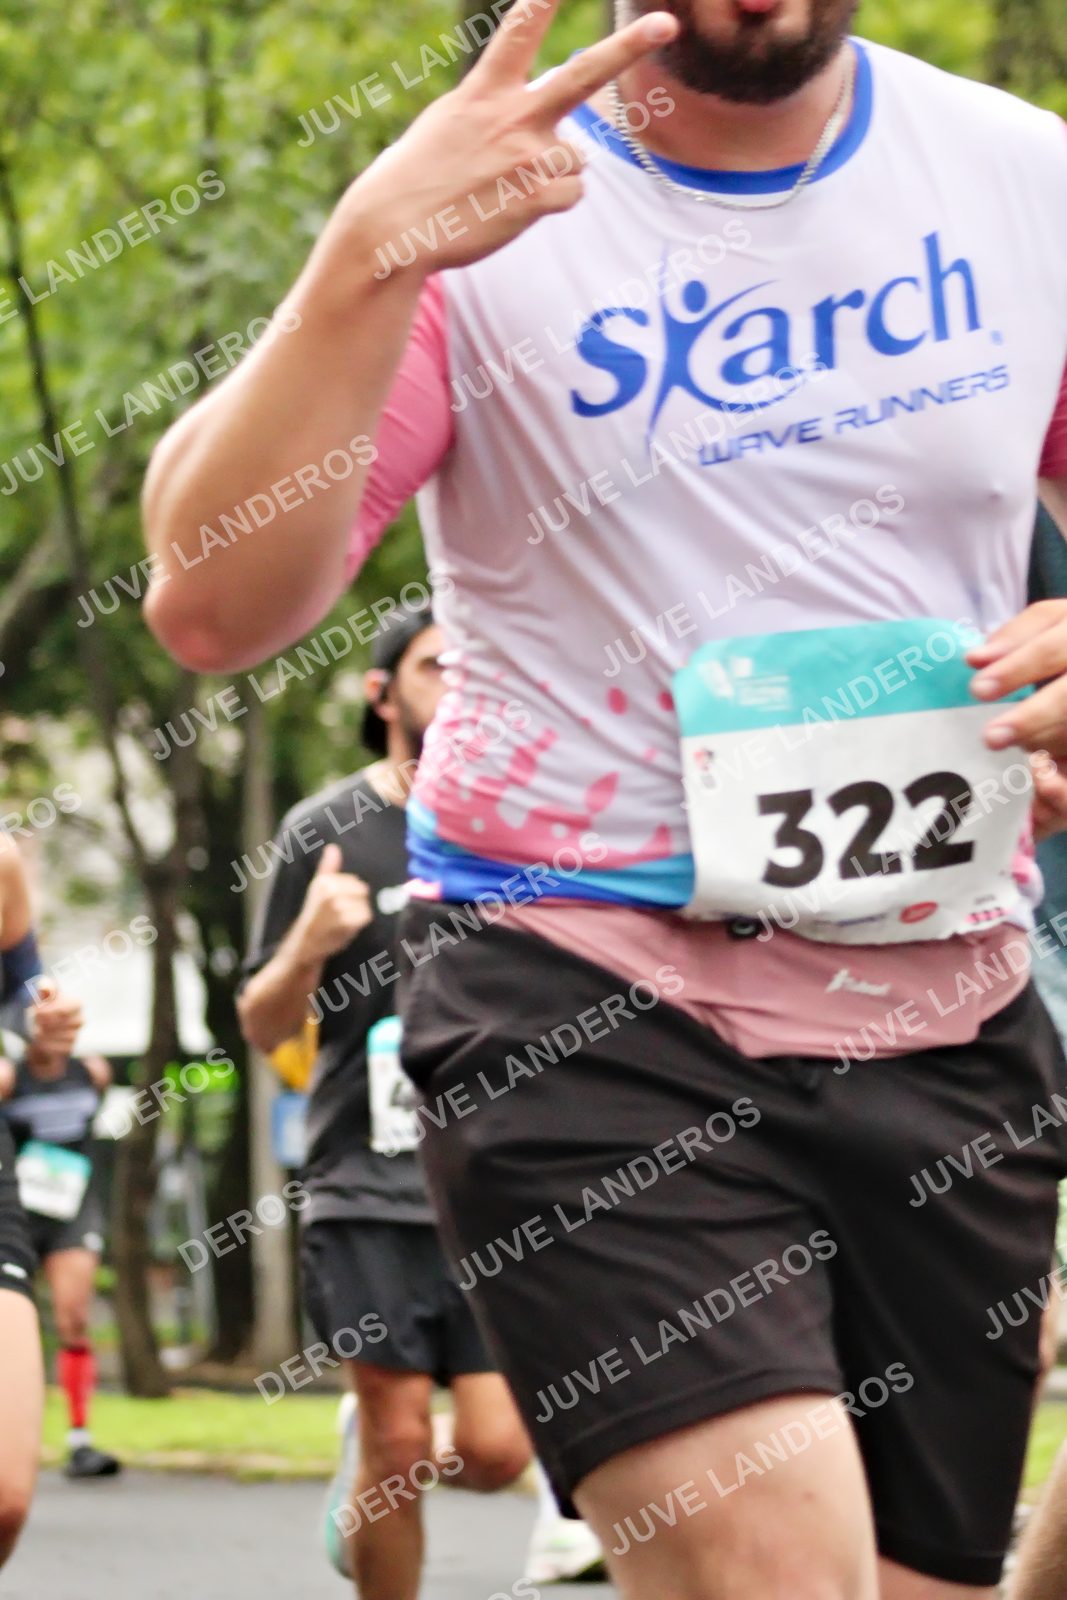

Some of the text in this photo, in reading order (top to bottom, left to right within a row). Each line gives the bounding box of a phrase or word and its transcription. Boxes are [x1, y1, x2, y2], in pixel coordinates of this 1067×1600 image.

[698, 364, 1010, 467] WAVE RUNNERS
[757, 771, 976, 889] 322
